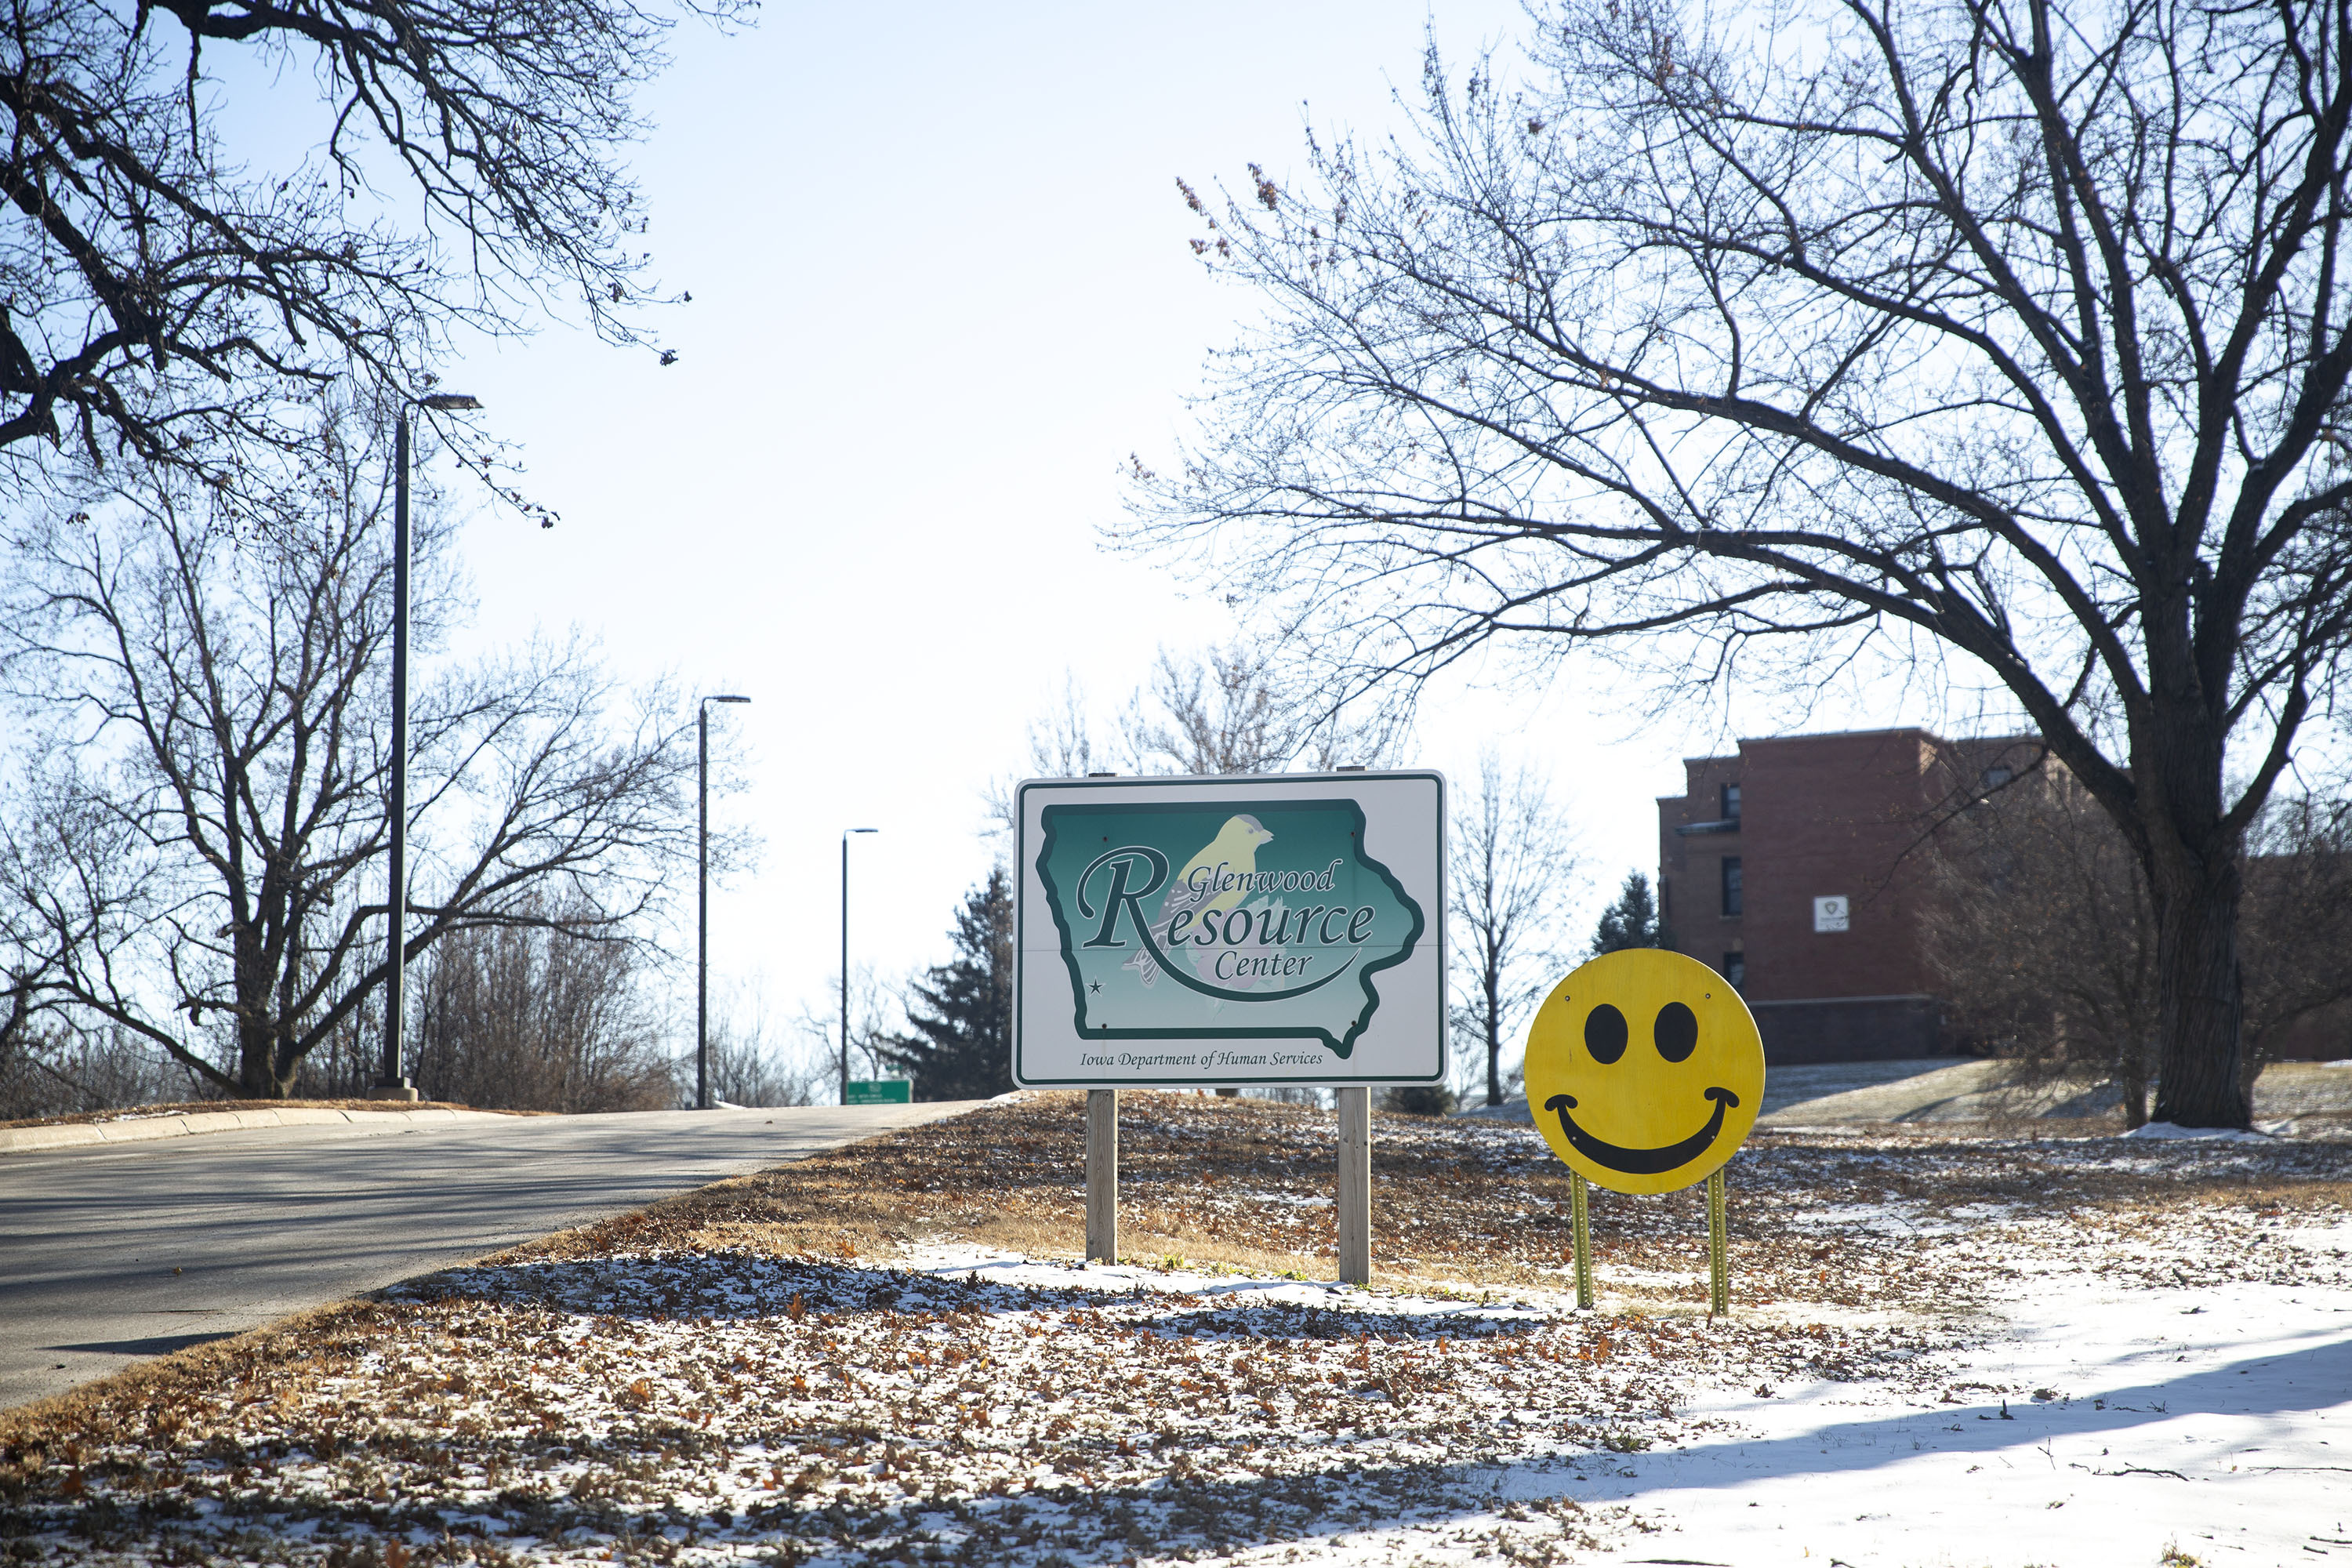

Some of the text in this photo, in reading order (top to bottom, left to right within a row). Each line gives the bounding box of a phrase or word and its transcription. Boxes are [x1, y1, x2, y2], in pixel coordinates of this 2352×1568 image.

[1187, 858, 1344, 902] Glenwood
[1076, 845, 1375, 1002] Resource
[1214, 950, 1313, 980] Center
[1080, 1050, 1323, 1069] Iowa Department of Human Services
